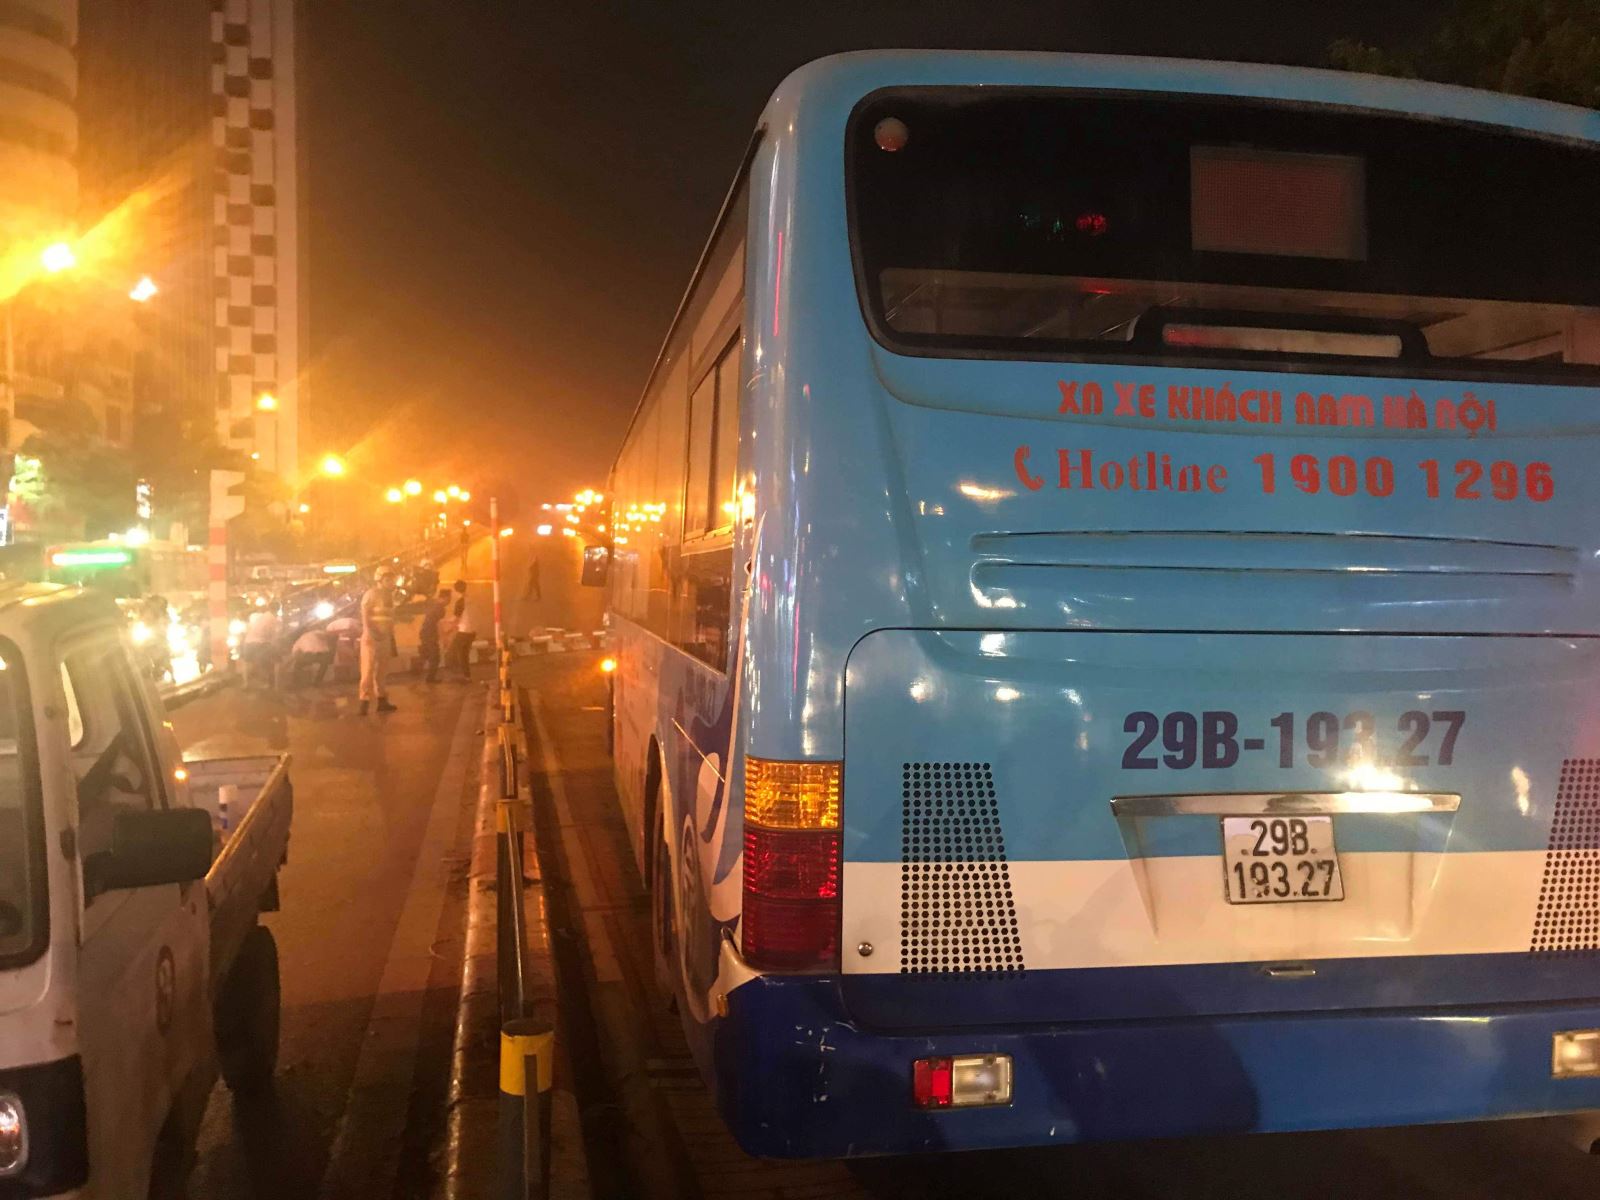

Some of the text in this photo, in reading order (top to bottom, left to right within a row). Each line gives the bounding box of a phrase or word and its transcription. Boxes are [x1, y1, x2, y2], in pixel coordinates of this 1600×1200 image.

[1113, 381, 1157, 418] XE
[1167, 381, 1283, 424] KHÁCH
[1383, 388, 1428, 430] HÀ
[1057, 448, 1555, 502] Hotline 1900 1296
[1250, 818, 1309, 857] 29B
[1233, 859, 1335, 899] 193.27
